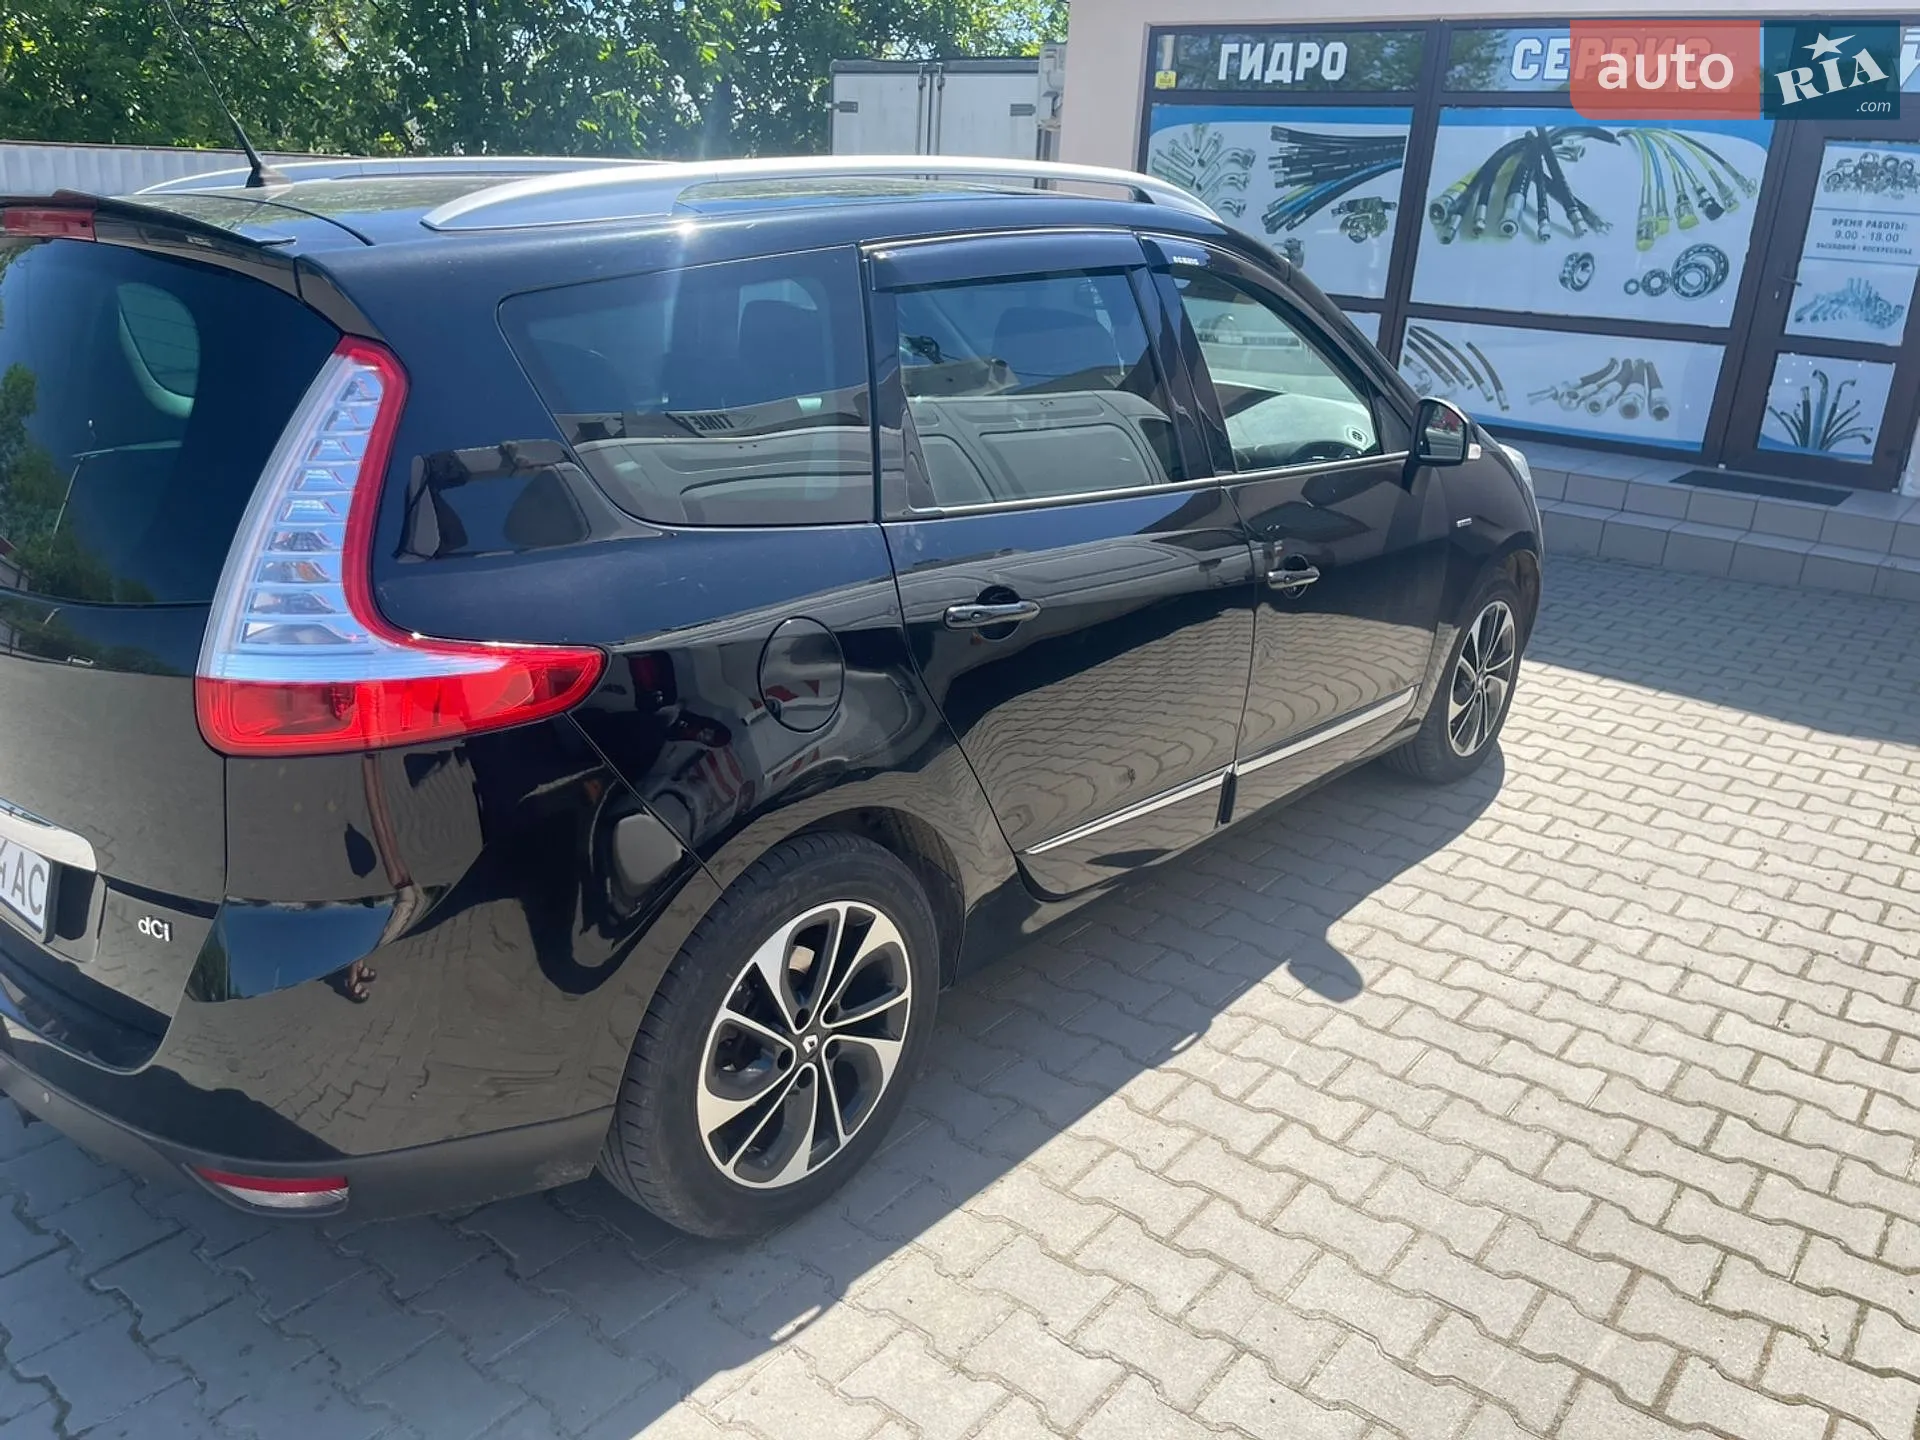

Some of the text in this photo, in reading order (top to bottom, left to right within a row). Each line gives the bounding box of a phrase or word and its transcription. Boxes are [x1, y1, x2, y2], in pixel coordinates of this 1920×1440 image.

[1218, 42, 1347, 83] ГИДРО
[1835, 230, 1858, 240] 9.00
[1870, 232, 1899, 243] 18.00
[138, 916, 171, 942] dCi
